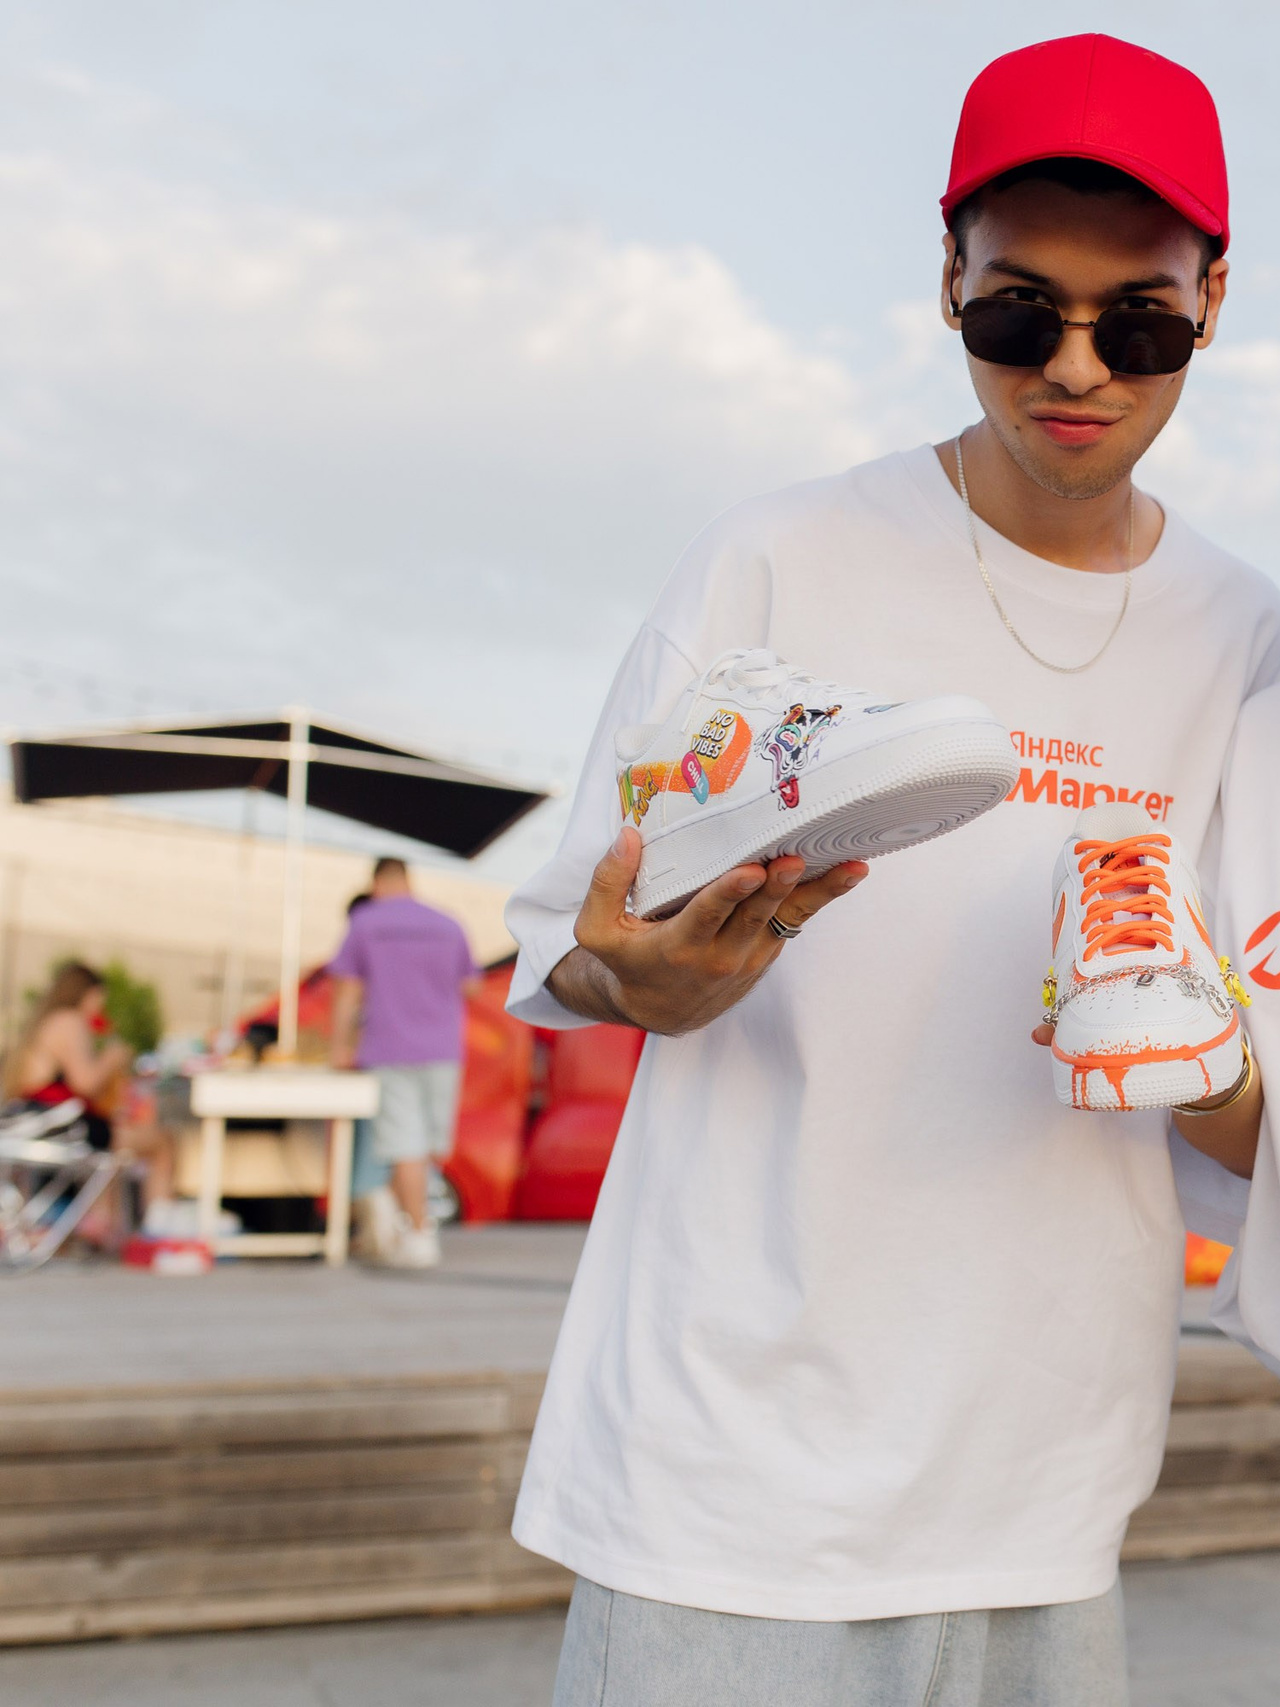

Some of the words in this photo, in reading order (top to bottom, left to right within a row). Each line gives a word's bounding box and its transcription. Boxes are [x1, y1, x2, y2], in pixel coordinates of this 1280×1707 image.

[711, 711, 735, 728] NO
[700, 723, 727, 742] BAD
[692, 737, 722, 759] VIBES
[1010, 731, 1104, 767] Яндекс
[687, 760, 705, 794] CHILL
